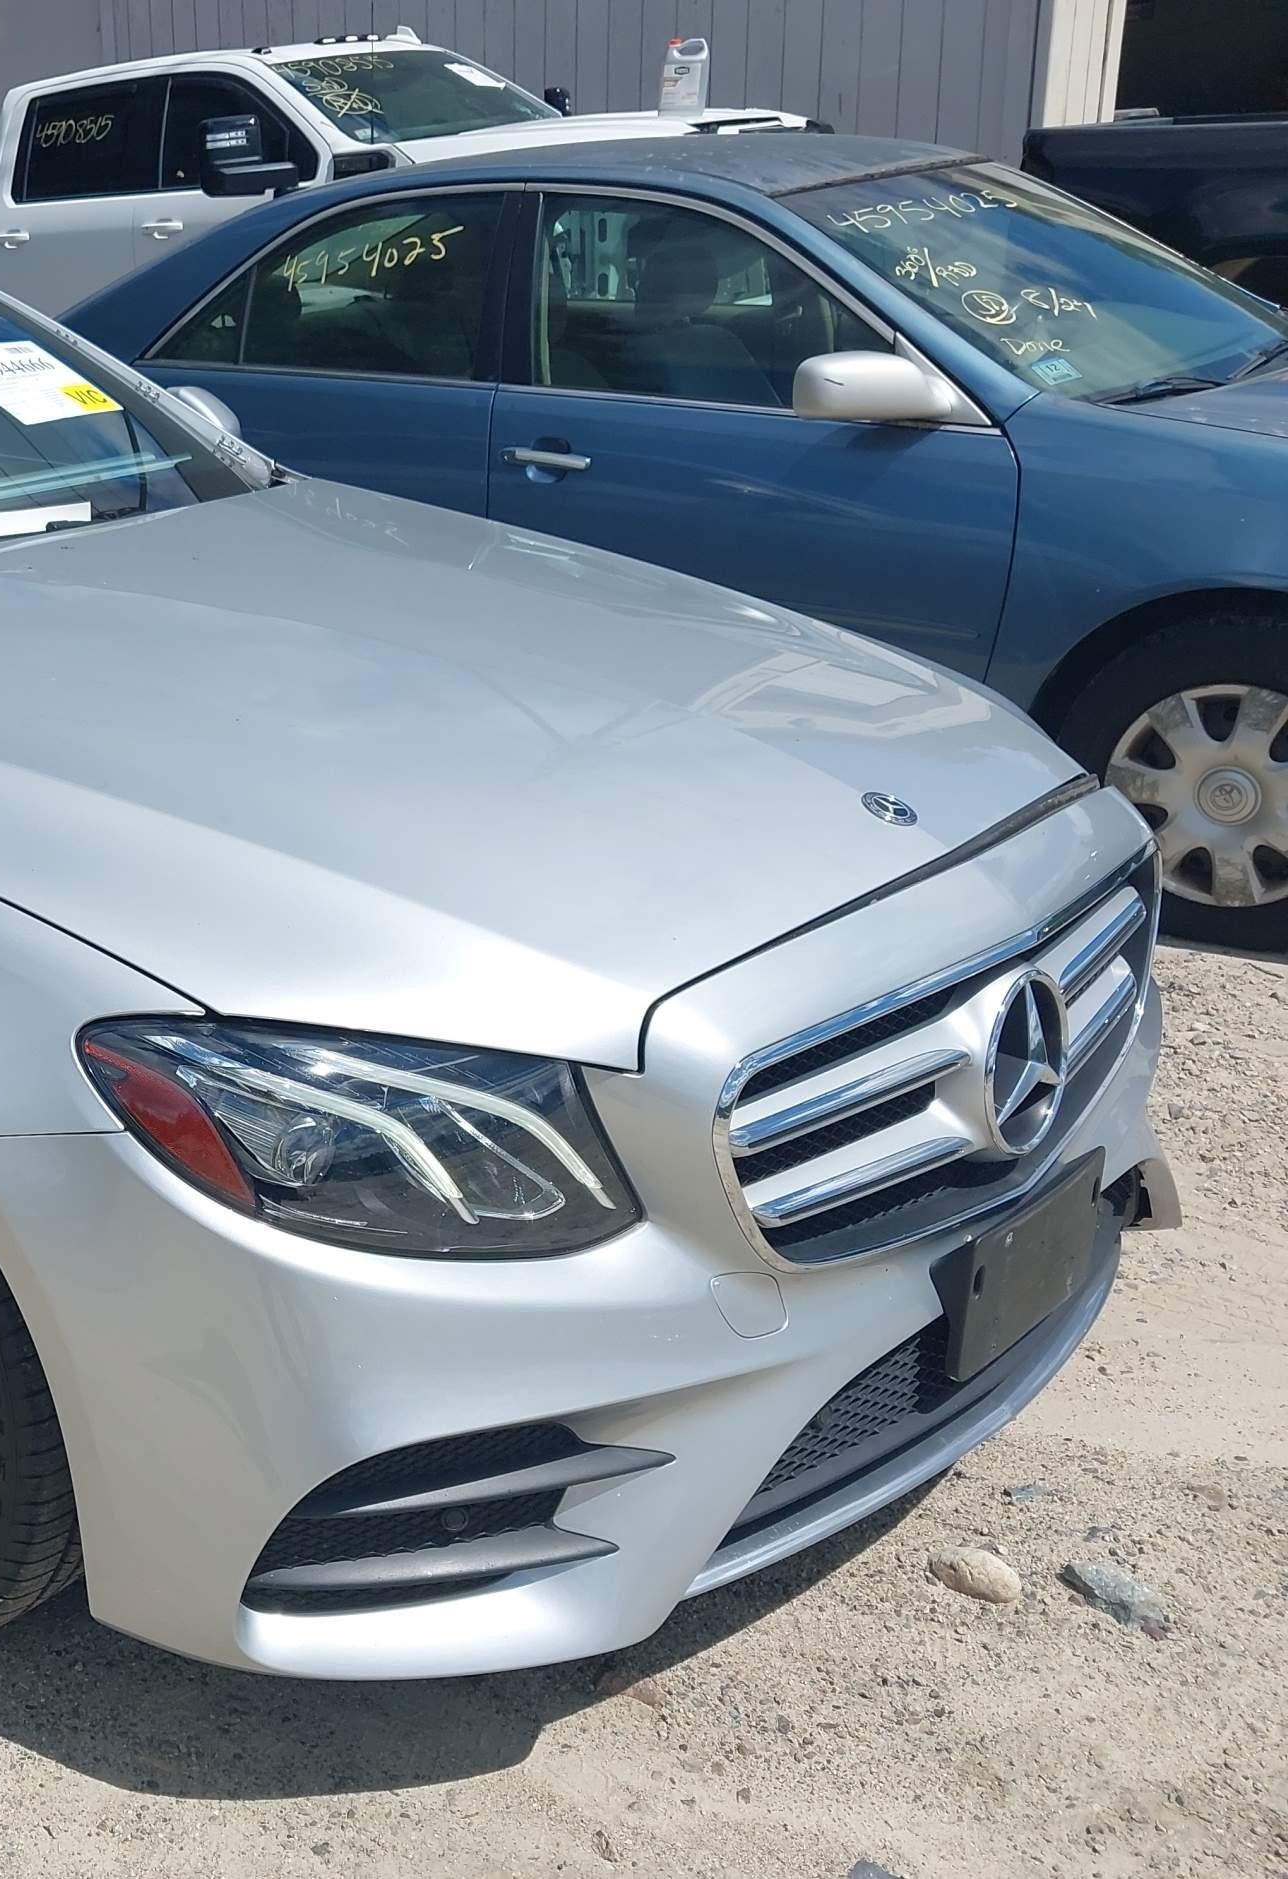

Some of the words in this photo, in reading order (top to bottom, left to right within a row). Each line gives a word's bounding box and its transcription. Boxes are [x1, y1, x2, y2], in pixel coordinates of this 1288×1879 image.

[35, 114, 115, 148] 45908515
[826, 189, 1018, 233] 45954025
[283, 225, 465, 292] 45954025
[1000, 338, 1071, 355] Done
[1045, 363, 1061, 373] 12
[64, 389, 108, 405] VIC
